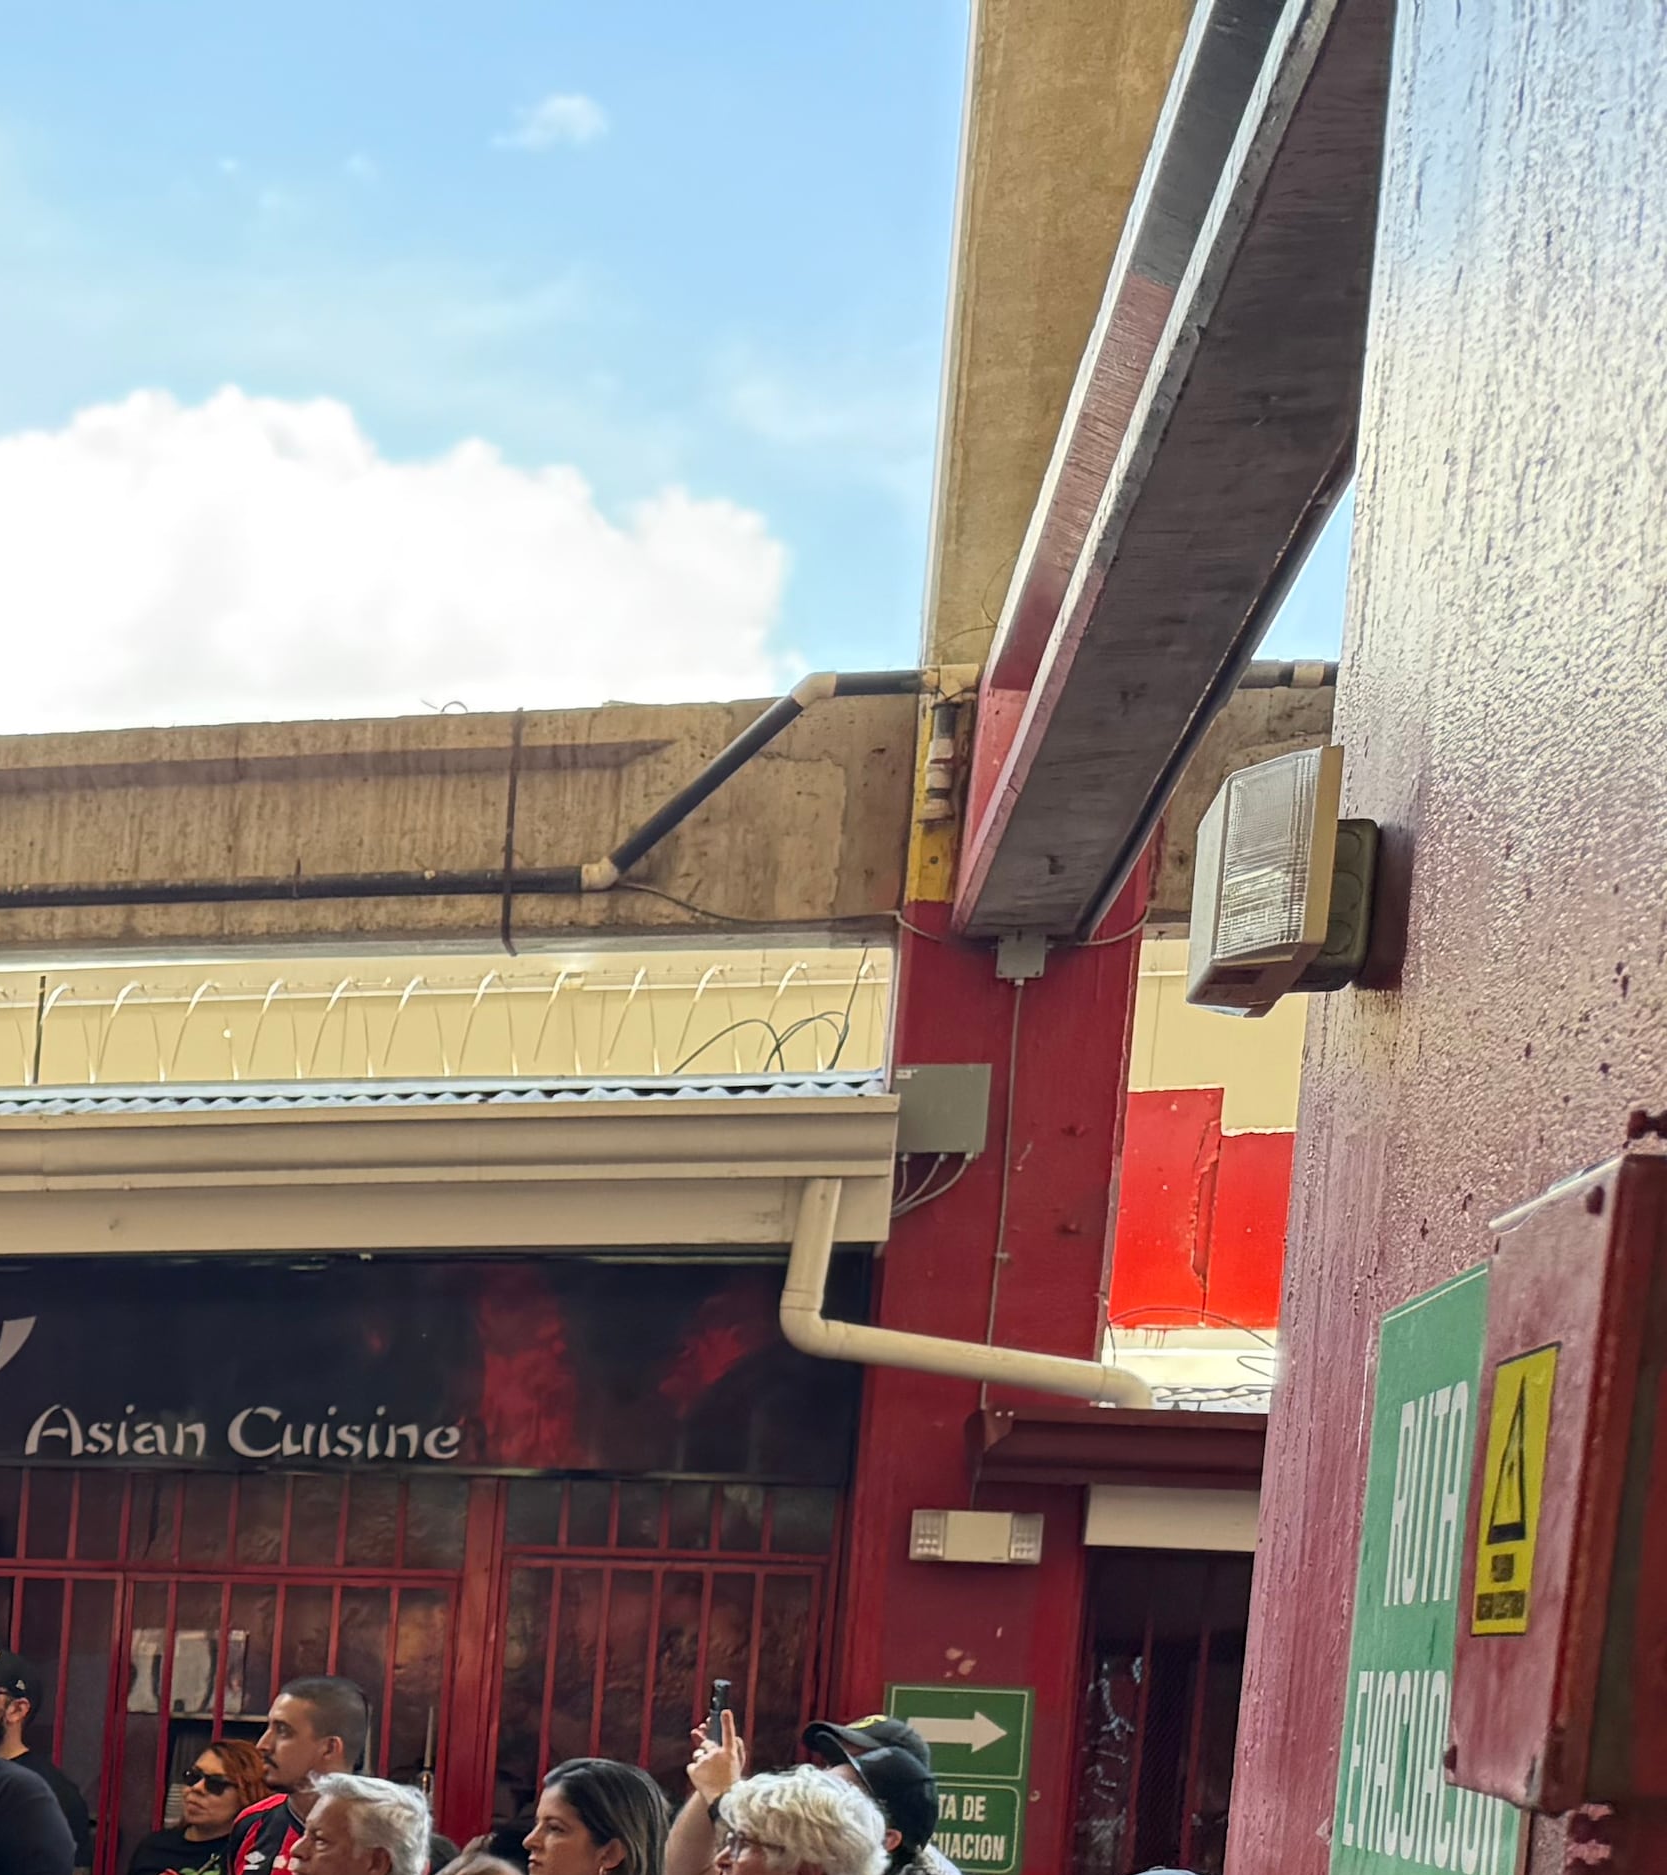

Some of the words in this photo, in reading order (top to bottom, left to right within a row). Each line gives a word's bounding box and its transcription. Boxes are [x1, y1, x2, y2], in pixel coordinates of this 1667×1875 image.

[24, 1404, 208, 1457] Asian
[227, 1405, 463, 1460] Cuisine
[1383, 1380, 1468, 1607] RUTA
[962, 1795, 986, 1821] DE
[933, 1832, 1005, 1861] UACION
